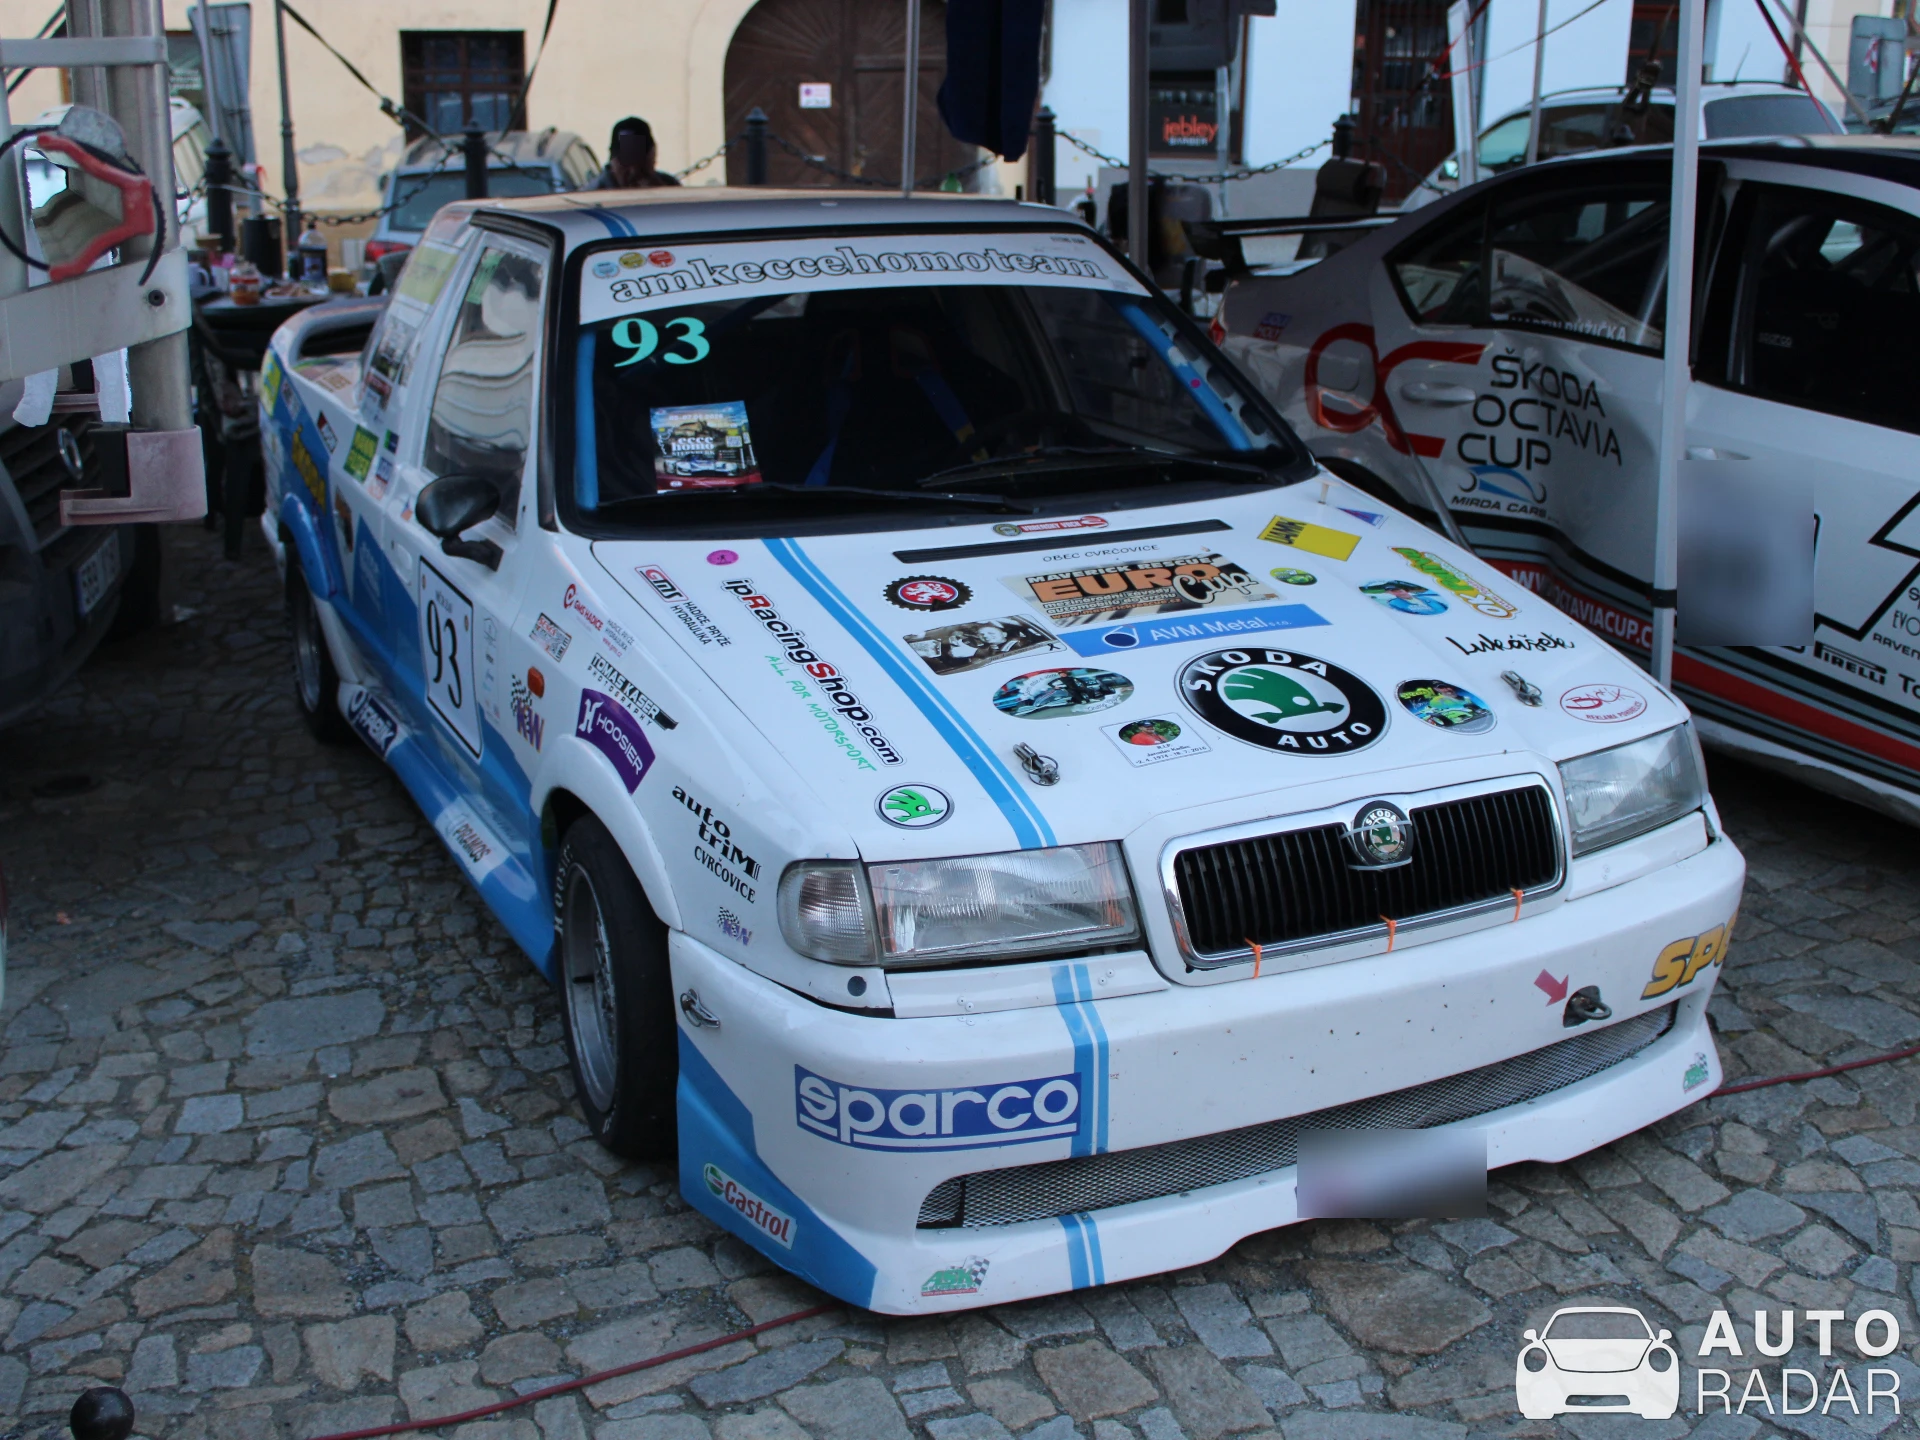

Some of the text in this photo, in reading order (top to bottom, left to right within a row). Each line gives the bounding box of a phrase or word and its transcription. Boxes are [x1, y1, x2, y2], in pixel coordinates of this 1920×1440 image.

[610, 247, 1108, 302] amkeccehomoteam
[611, 317, 710, 368] 93
[1490, 347, 1606, 419] ŠKODA
[1457, 432, 1551, 470] CUP
[1473, 394, 1623, 467] OCTAVIA
[1451, 495, 1501, 511] MIRDA
[1027, 557, 1213, 584] MAVERICK RESCUE
[1042, 545, 1160, 562] OBEC CVRČOVICE
[1030, 563, 1221, 603] EURO
[1172, 572, 1260, 604] Cup
[670, 604, 712, 645] HYDRAULIKA
[682, 601, 732, 647] HADICE, PRYŽE
[1150, 624, 1203, 642] AVM
[1203, 617, 1268, 634] Metal
[427, 599, 463, 710] 93
[725, 579, 900, 764] ipRacingShop.com
[1813, 640, 1888, 686] PIRELLI
[588, 665, 653, 726] PHOTOGRAPHY
[764, 654, 878, 772] ALL FOR MOTORSPORT
[596, 713, 643, 776] HOOSIER
[1277, 722, 1373, 749] AUTO
[672, 784, 731, 839] auto
[1365, 810, 1397, 826] SKODA
[693, 845, 756, 905] CVRČOVICE
[800, 1075, 1079, 1144] sparco
[724, 1181, 791, 1245] Castrol
